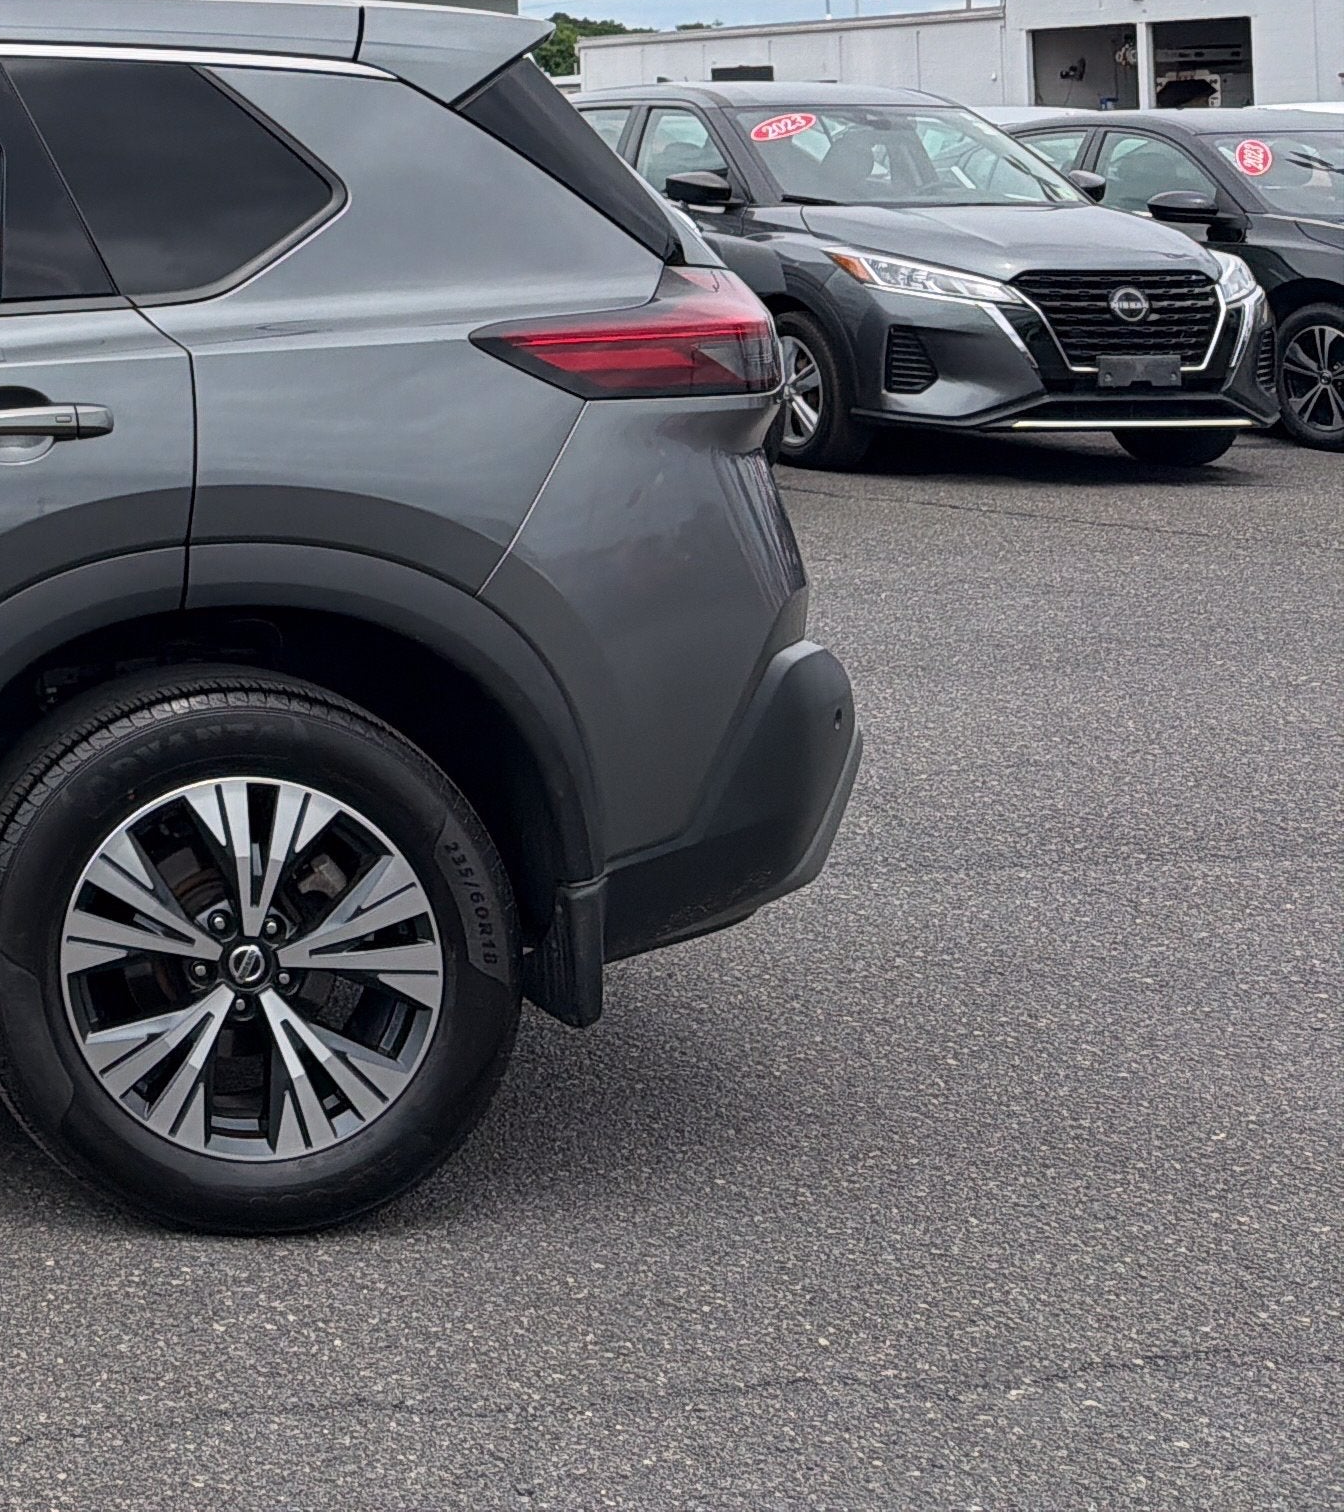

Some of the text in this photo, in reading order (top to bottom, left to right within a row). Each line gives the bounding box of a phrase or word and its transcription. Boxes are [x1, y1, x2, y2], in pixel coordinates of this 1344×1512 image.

[761, 115, 807, 138] 2023
[1242, 143, 1264, 170] 2023
[444, 841, 498, 965] 235/60R18
